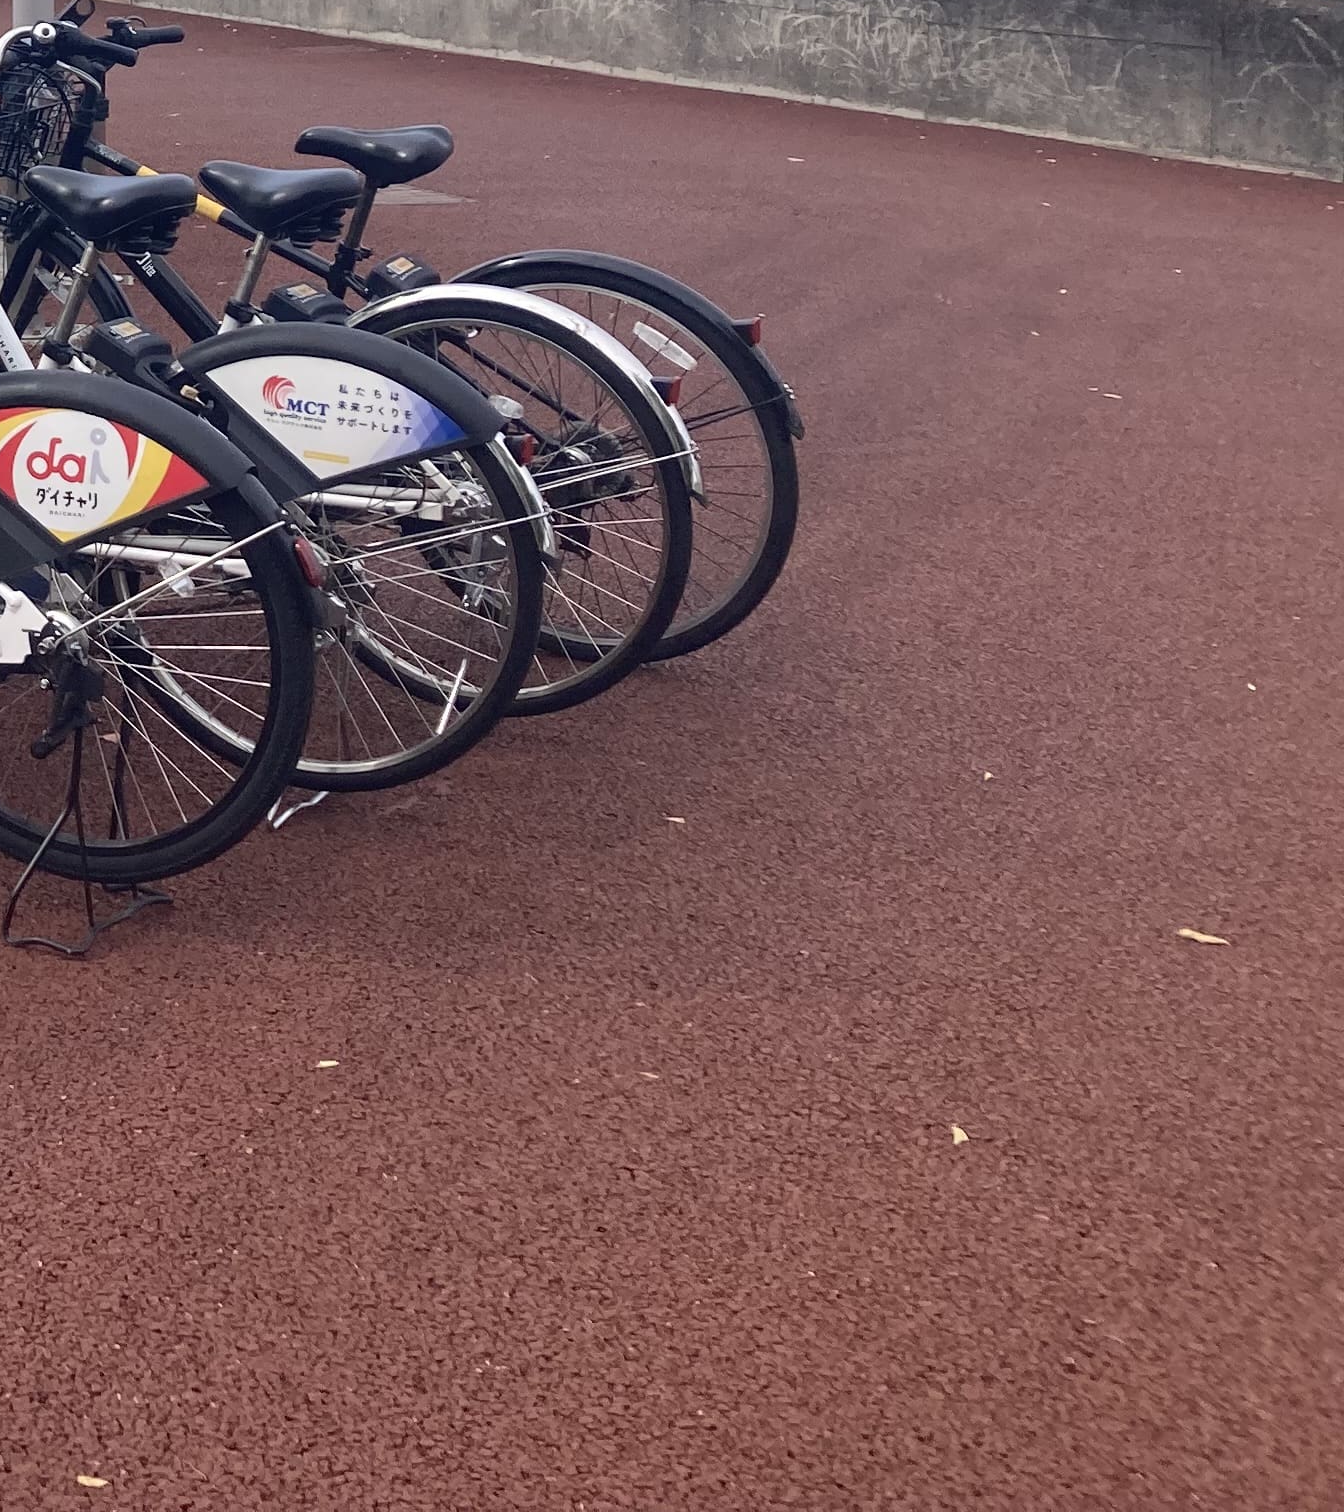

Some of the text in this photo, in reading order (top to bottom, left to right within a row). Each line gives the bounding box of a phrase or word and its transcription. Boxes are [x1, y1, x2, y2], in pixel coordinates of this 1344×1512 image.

[338, 383, 400, 401] 私たちは
[285, 397, 330, 417] MCT
[337, 400, 413, 420] 未来づくりを
[336, 417, 413, 435] サポートします
[36, 487, 98, 510] ダイチャリ
